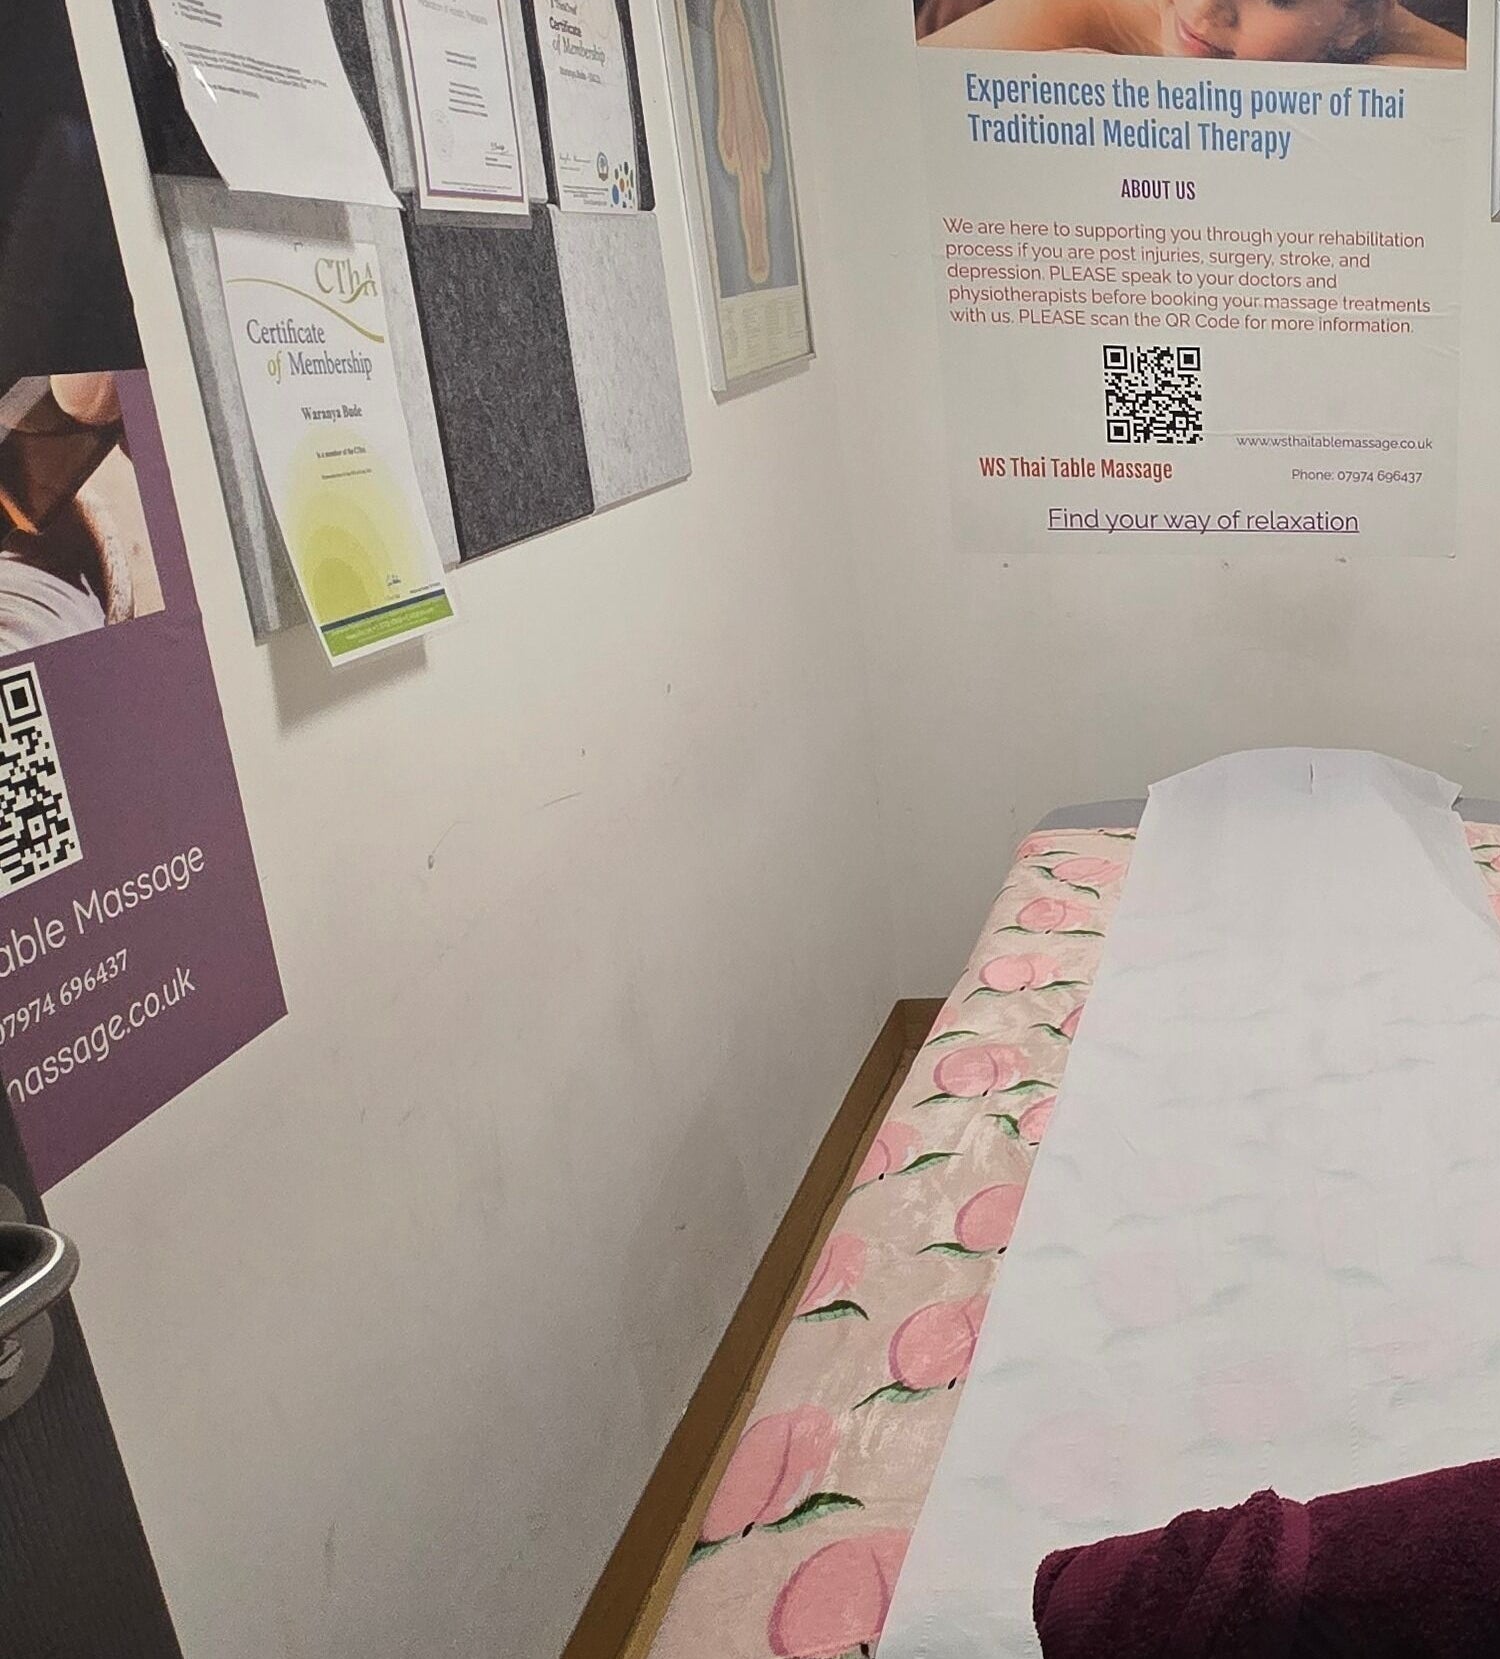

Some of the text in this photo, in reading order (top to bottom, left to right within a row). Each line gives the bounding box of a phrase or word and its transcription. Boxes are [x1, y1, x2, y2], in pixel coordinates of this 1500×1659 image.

[966, 73, 1405, 119] Experiences the healing power of Thai
[968, 113, 1291, 160] Traditional Medical Therapy
[1121, 179, 1196, 200] ABOUT US
[943, 217, 1425, 248] We are here to supporting you through your rehabilitation
[945, 242, 1371, 268] process if you are post injuries, surgery, stroke, and
[315, 258, 378, 303] CThA
[1049, 265, 1117, 283] PLEASE
[1121, 269, 1172, 286] speak
[1176, 271, 1193, 286] to
[1196, 273, 1234, 289] your
[1238, 272, 1302, 289] doctors
[1306, 274, 1338, 289] and
[949, 285, 1431, 313] physiotherapists before booking your massage treatments
[246, 319, 326, 344] Certificate
[950, 307, 1414, 333] with us. PLEASE scan the QR Code for more information.
[267, 351, 373, 384] of Membership
[301, 406, 341, 422] Waranya
[1236, 435, 1433, 452] www.wsthaitablemassage.co.uk
[979, 456, 1173, 483] WS Thai Table Massage
[1292, 469, 1423, 484] Phone: 07974 696437
[1048, 508, 1359, 534] Find your way of relaxation
[0, 846, 205, 978] able Massage
[60, 948, 128, 1006] 696437
